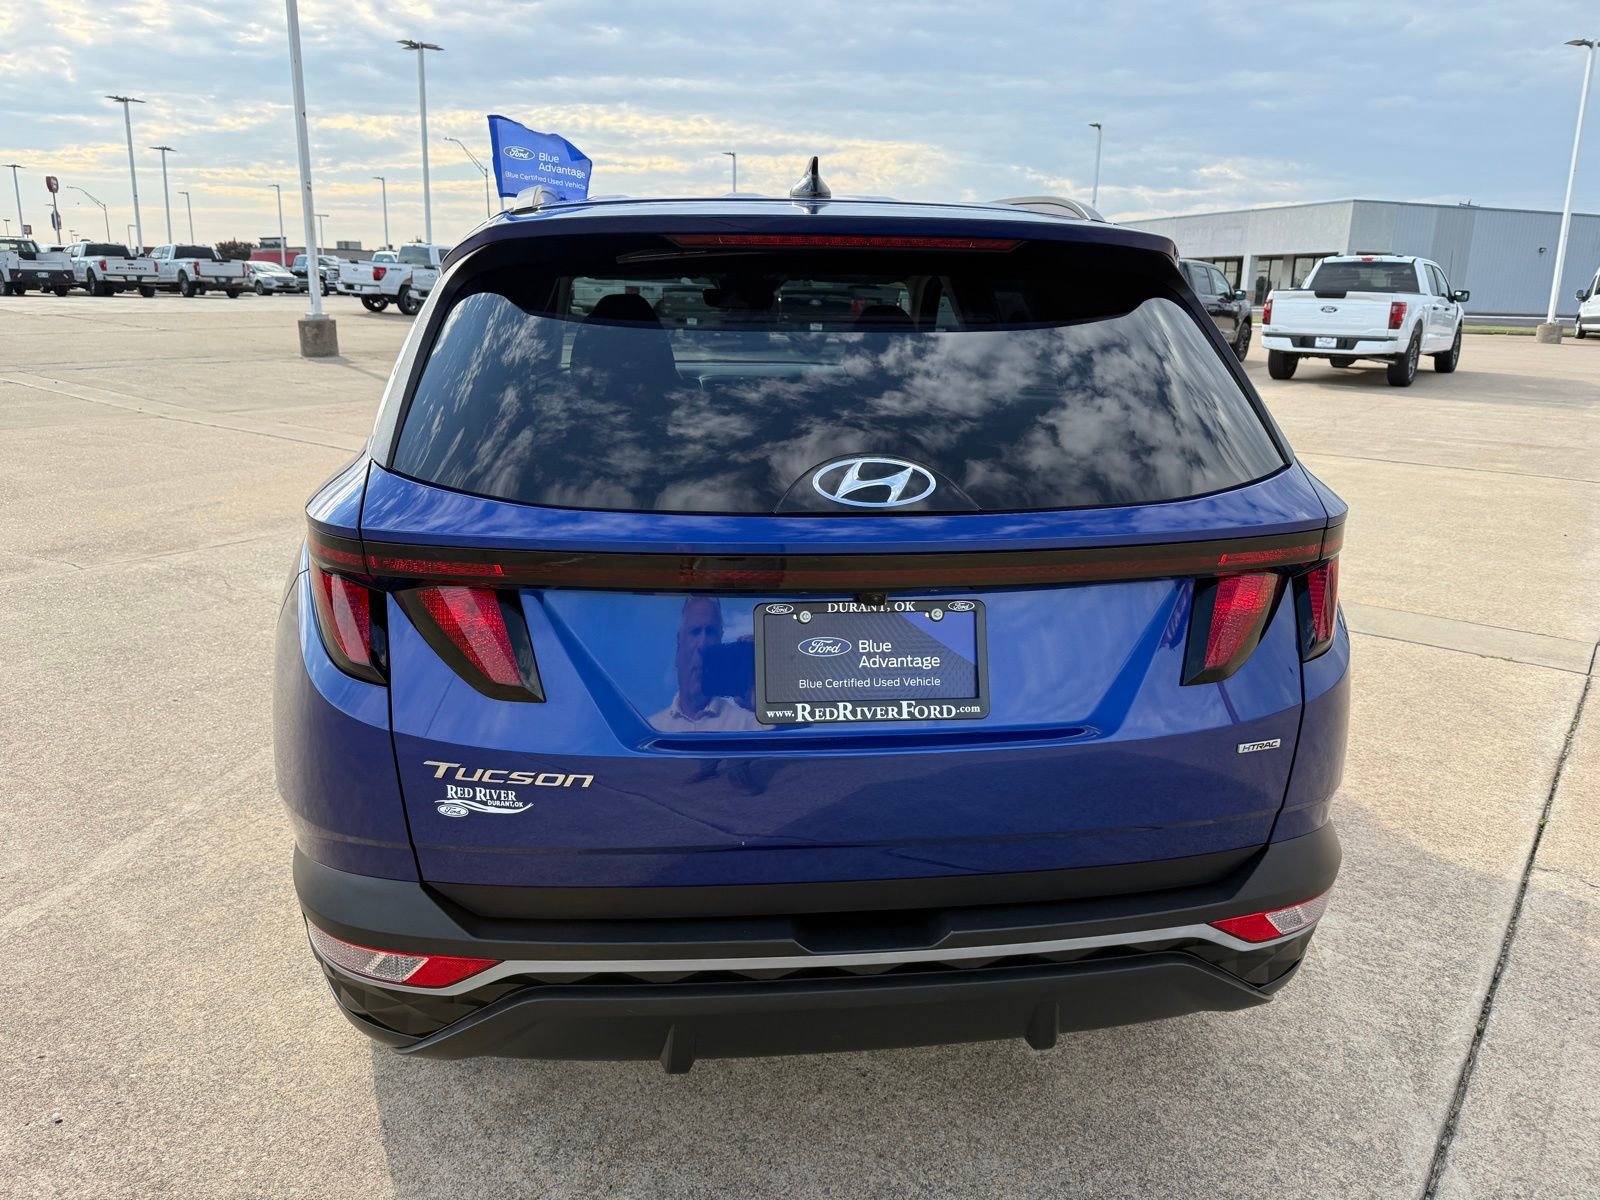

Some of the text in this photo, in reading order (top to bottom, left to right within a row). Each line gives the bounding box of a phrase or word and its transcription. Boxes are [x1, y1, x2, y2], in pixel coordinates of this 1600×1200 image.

[538, 152, 560, 163] Blue
[538, 162, 586, 179] Advantage
[505, 170, 586, 190] Blue Certified Used Vehicle
[894, 601, 916, 612] OK
[858, 639, 892, 653] Blue
[858, 654, 941, 670] Advantage
[798, 676, 941, 689] Blue Certified Used Vehicle
[1242, 740, 1279, 752] HTRAC
[423, 760, 594, 788] TUCSON
[446, 784, 517, 802] RED RIVER
